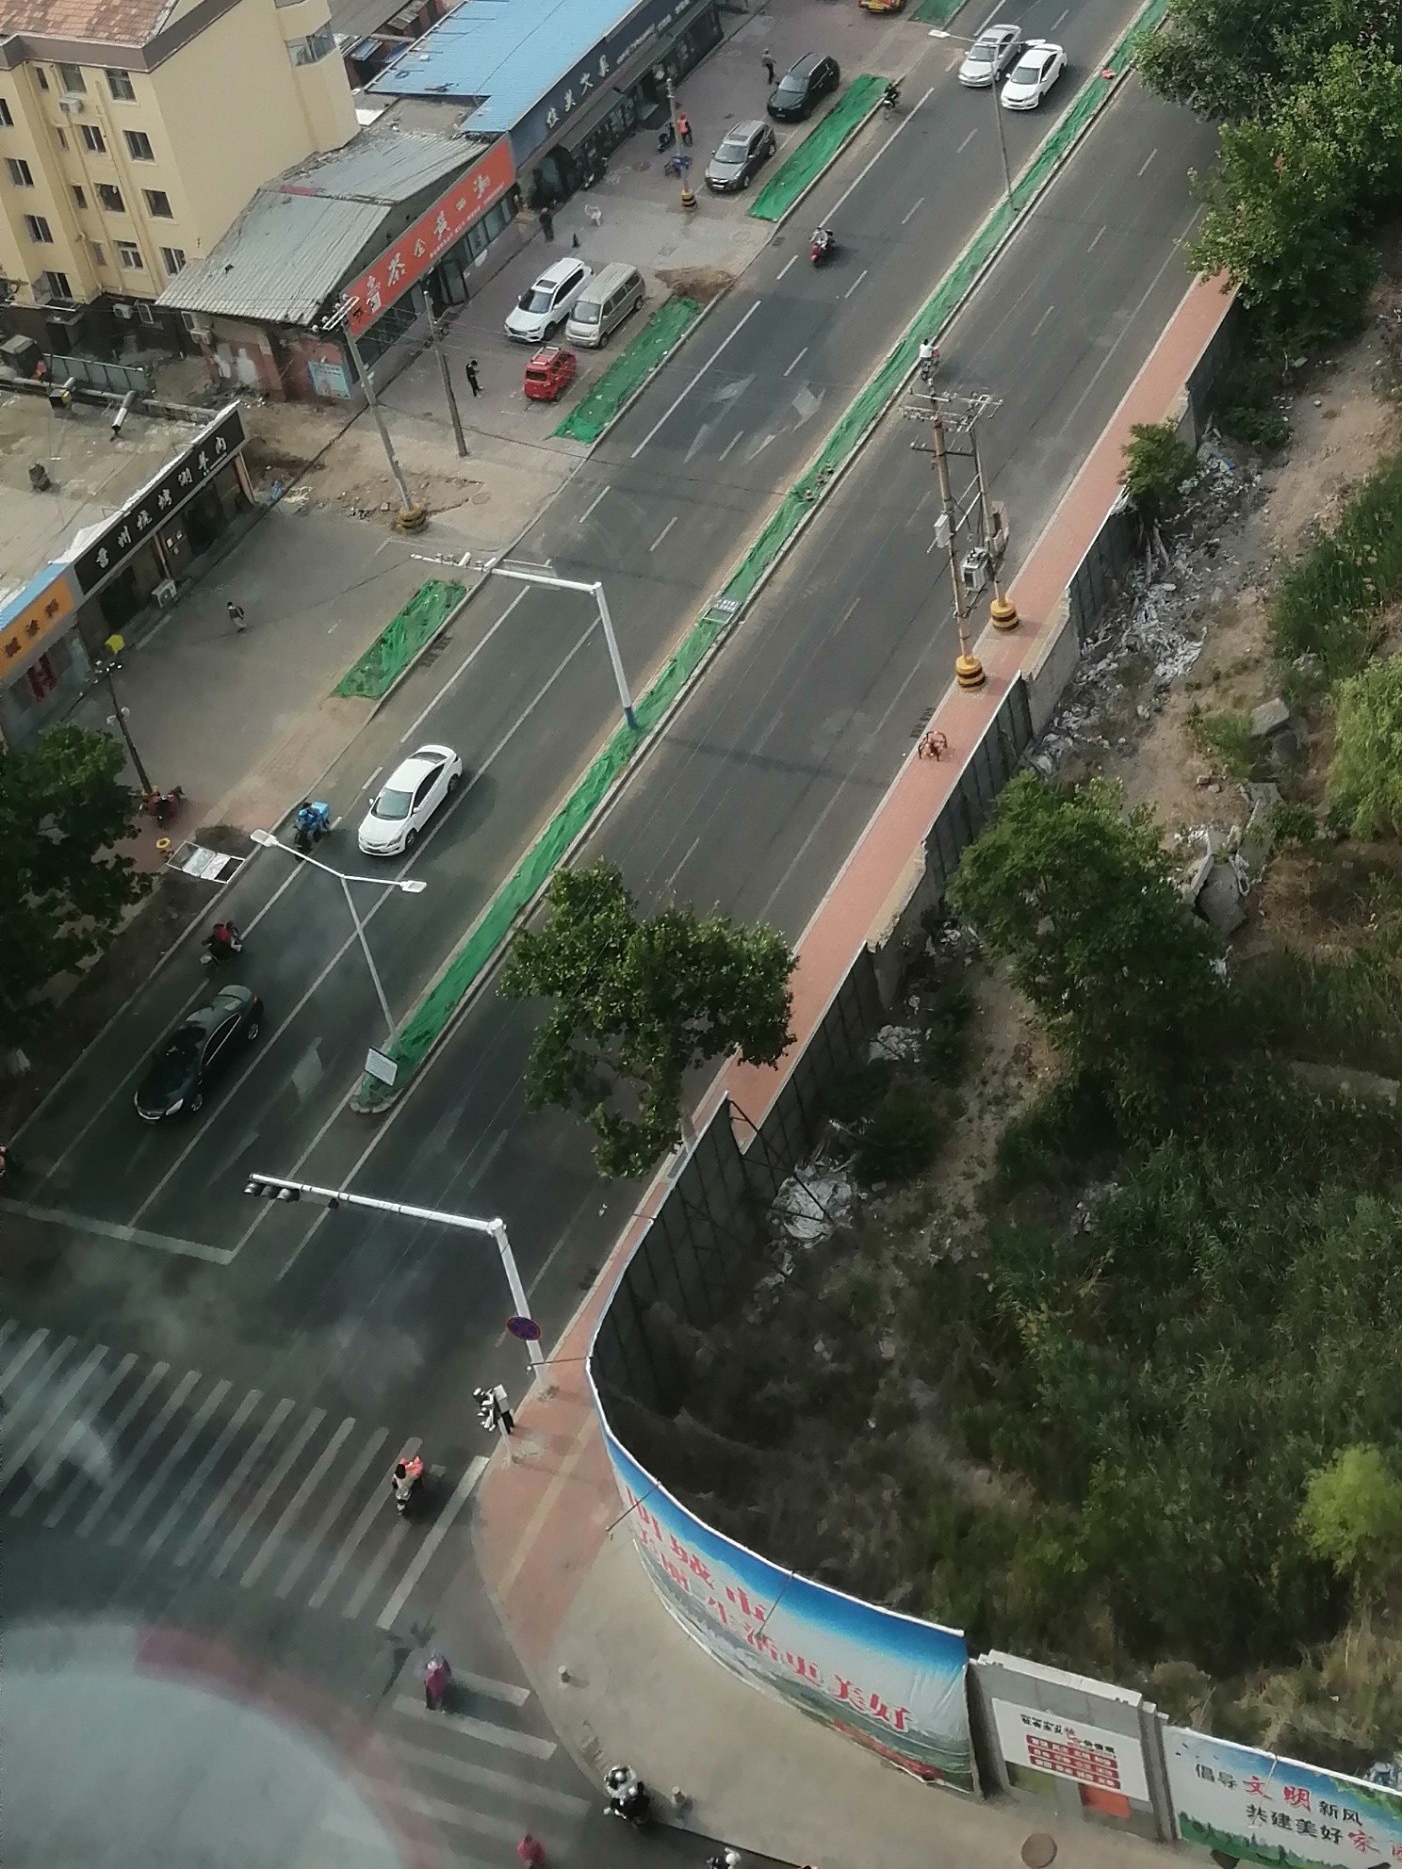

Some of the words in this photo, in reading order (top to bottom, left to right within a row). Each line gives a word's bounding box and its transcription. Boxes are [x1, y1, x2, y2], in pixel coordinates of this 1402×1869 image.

[1194, 1762, 1364, 1827] 倡导文明新风
